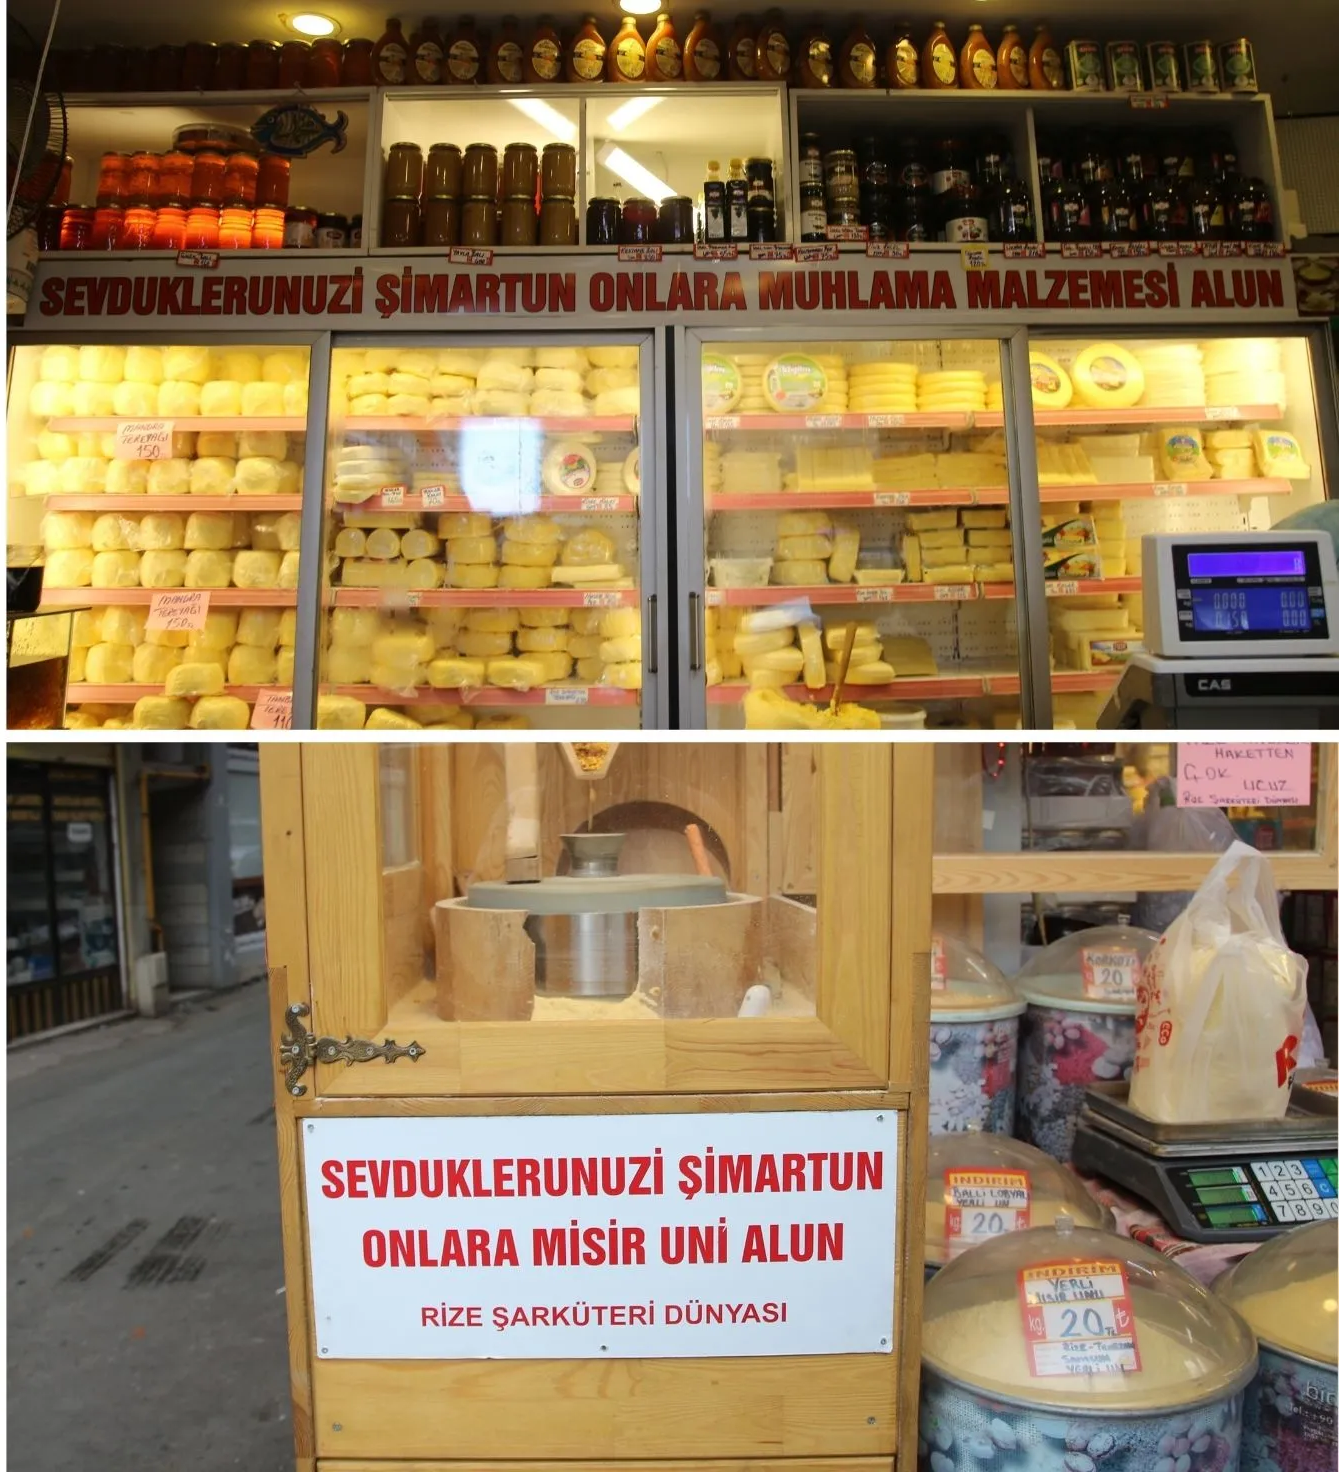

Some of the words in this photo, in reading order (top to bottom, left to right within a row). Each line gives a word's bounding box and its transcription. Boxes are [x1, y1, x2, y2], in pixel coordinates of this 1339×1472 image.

[39, 266, 364, 317] SEVDUKLERUNUZİ
[375, 265, 577, 319] ŞİMARTUN
[589, 271, 748, 313] ONLARA
[758, 270, 957, 311] MUHLAMA
[966, 262, 1181, 311] MALZEMESİ
[1191, 269, 1285, 309] ALUN
[136, 444, 160, 458] 150
[1198, 679, 1232, 692] CAS
[1099, 967, 1124, 986] 20
[321, 1147, 665, 1199] SEVDUKLERUNUZİ
[678, 1146, 884, 1201] ŞİMARTUN
[1259, 1166, 1267, 1178] 1
[1274, 1165, 1286, 1177] 2
[1291, 1164, 1303, 1176] 3
[1269, 1186, 1279, 1198] 4
[1285, 1184, 1296, 1196] 5
[1302, 1183, 1313, 1196] 6
[1277, 1205, 1286, 1218] 7
[1295, 1204, 1306, 1217] 8
[1313, 1203, 1324, 1216] 9
[971, 1211, 1004, 1234] 20
[362, 1228, 520, 1268] ONLARA
[532, 1218, 647, 1267] MİSİR
[660, 1217, 729, 1265] UNİ
[741, 1222, 845, 1263] ALUN
[421, 1302, 483, 1328] RİZE
[491, 1299, 656, 1332] ŞARKÜTERİ
[665, 1299, 789, 1326] DÜNYASI
[1060, 1308, 1105, 1338] 20
